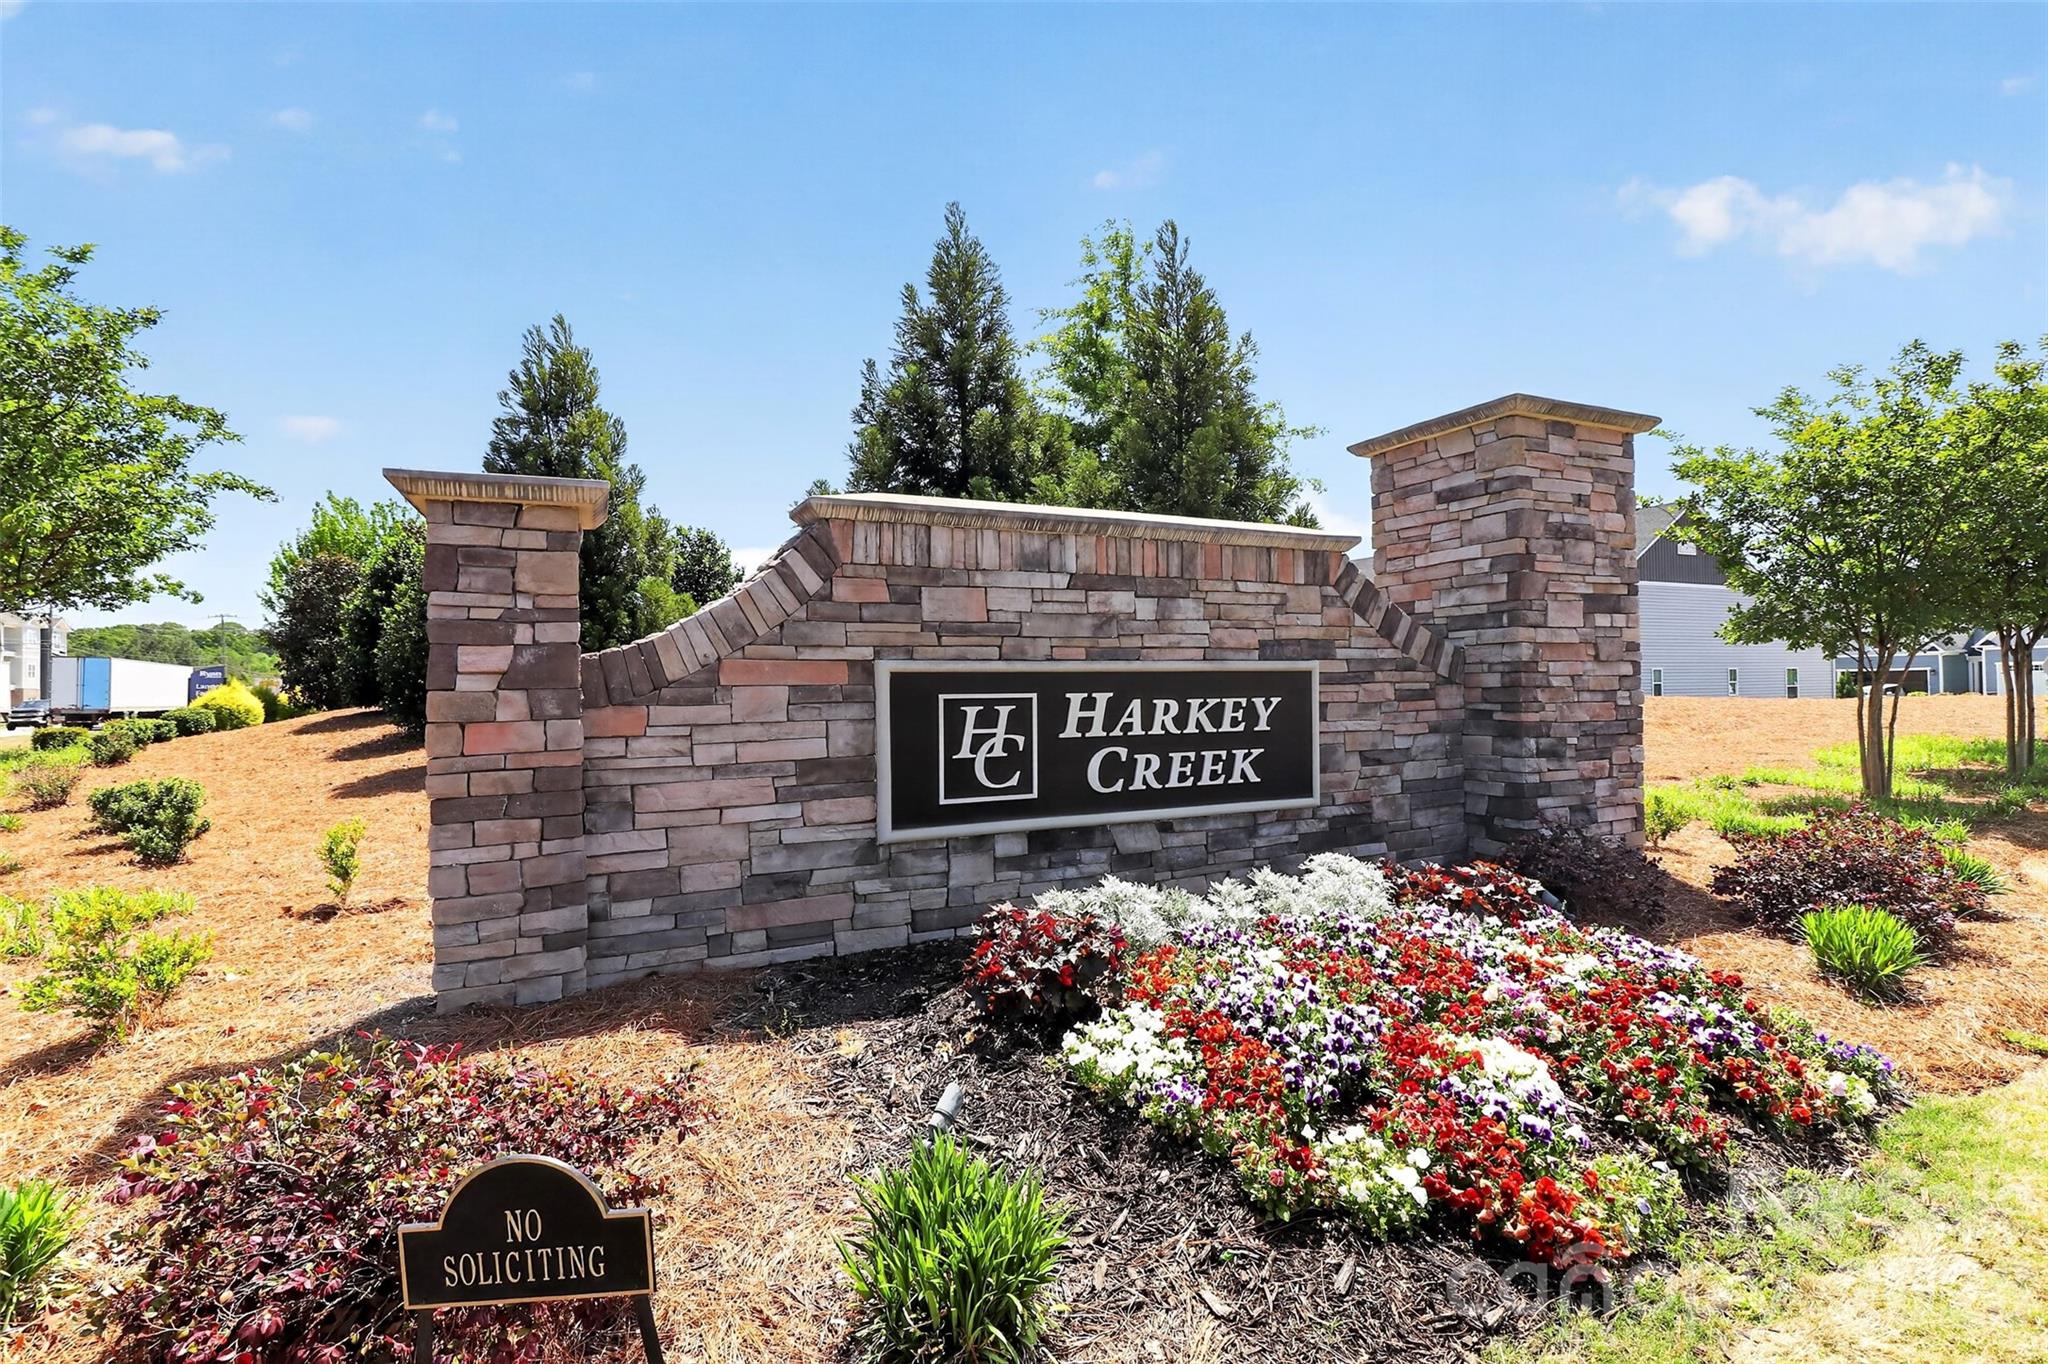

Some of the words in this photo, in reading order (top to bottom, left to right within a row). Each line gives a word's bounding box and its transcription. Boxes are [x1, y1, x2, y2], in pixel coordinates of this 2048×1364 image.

[1058, 692, 1282, 739] HARKEY
[1087, 746, 1265, 794] CREEK
[504, 1208, 542, 1243] NO
[443, 1245, 606, 1288] SOLICITING
